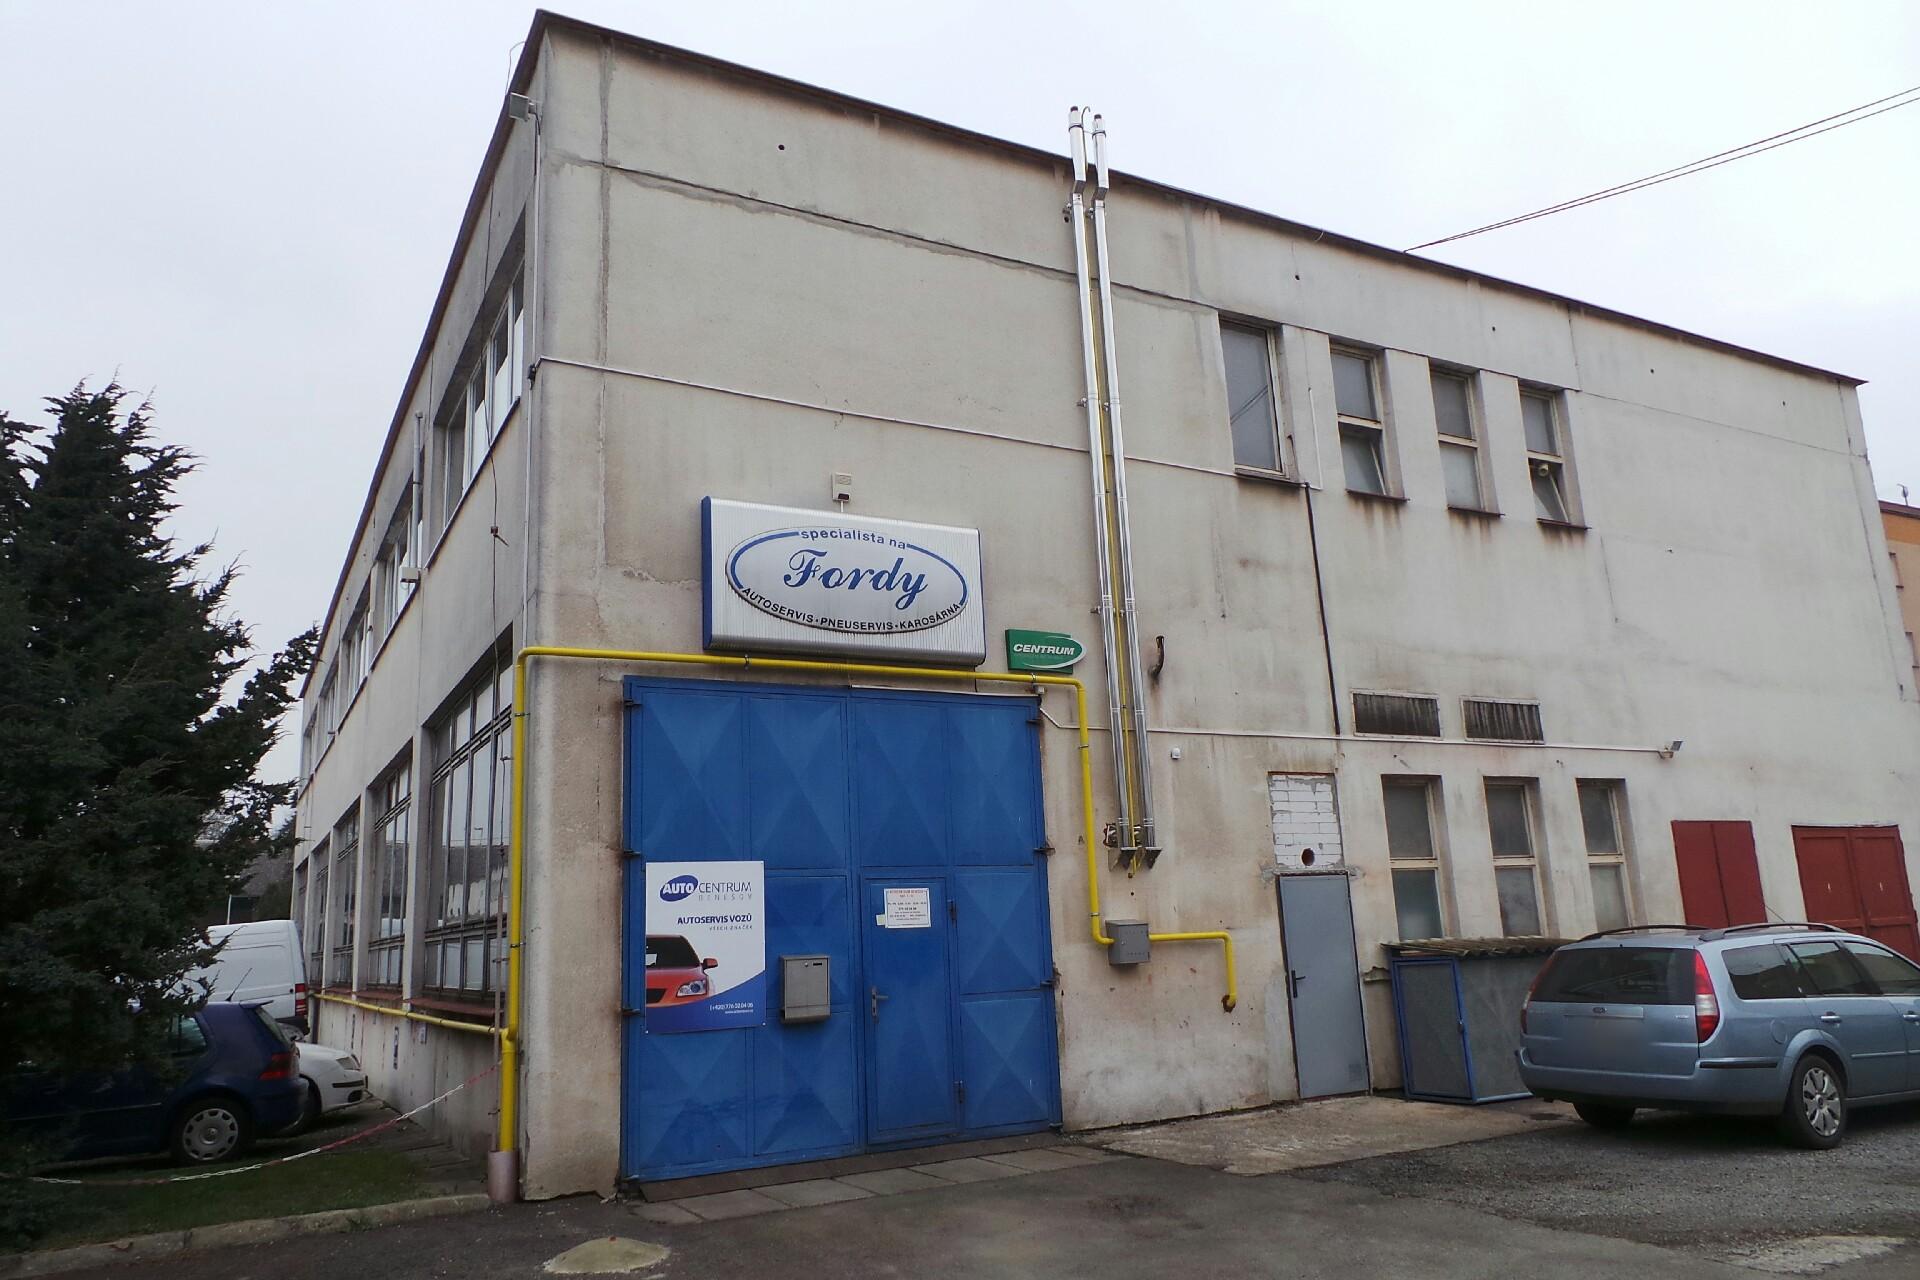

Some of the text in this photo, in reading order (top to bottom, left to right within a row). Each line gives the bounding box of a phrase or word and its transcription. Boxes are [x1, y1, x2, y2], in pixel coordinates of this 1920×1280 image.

[801, 528, 906, 549] specialista na
[783, 549, 928, 611] Fordy
[742, 588, 814, 622] AUTOSERVIS
[820, 617, 894, 631] PNEUSERVIS
[1013, 643, 1075, 656] CENTRUM
[662, 881, 752, 895] AUTO CENTRUM
[677, 915, 729, 925] AUTOSERVIS
